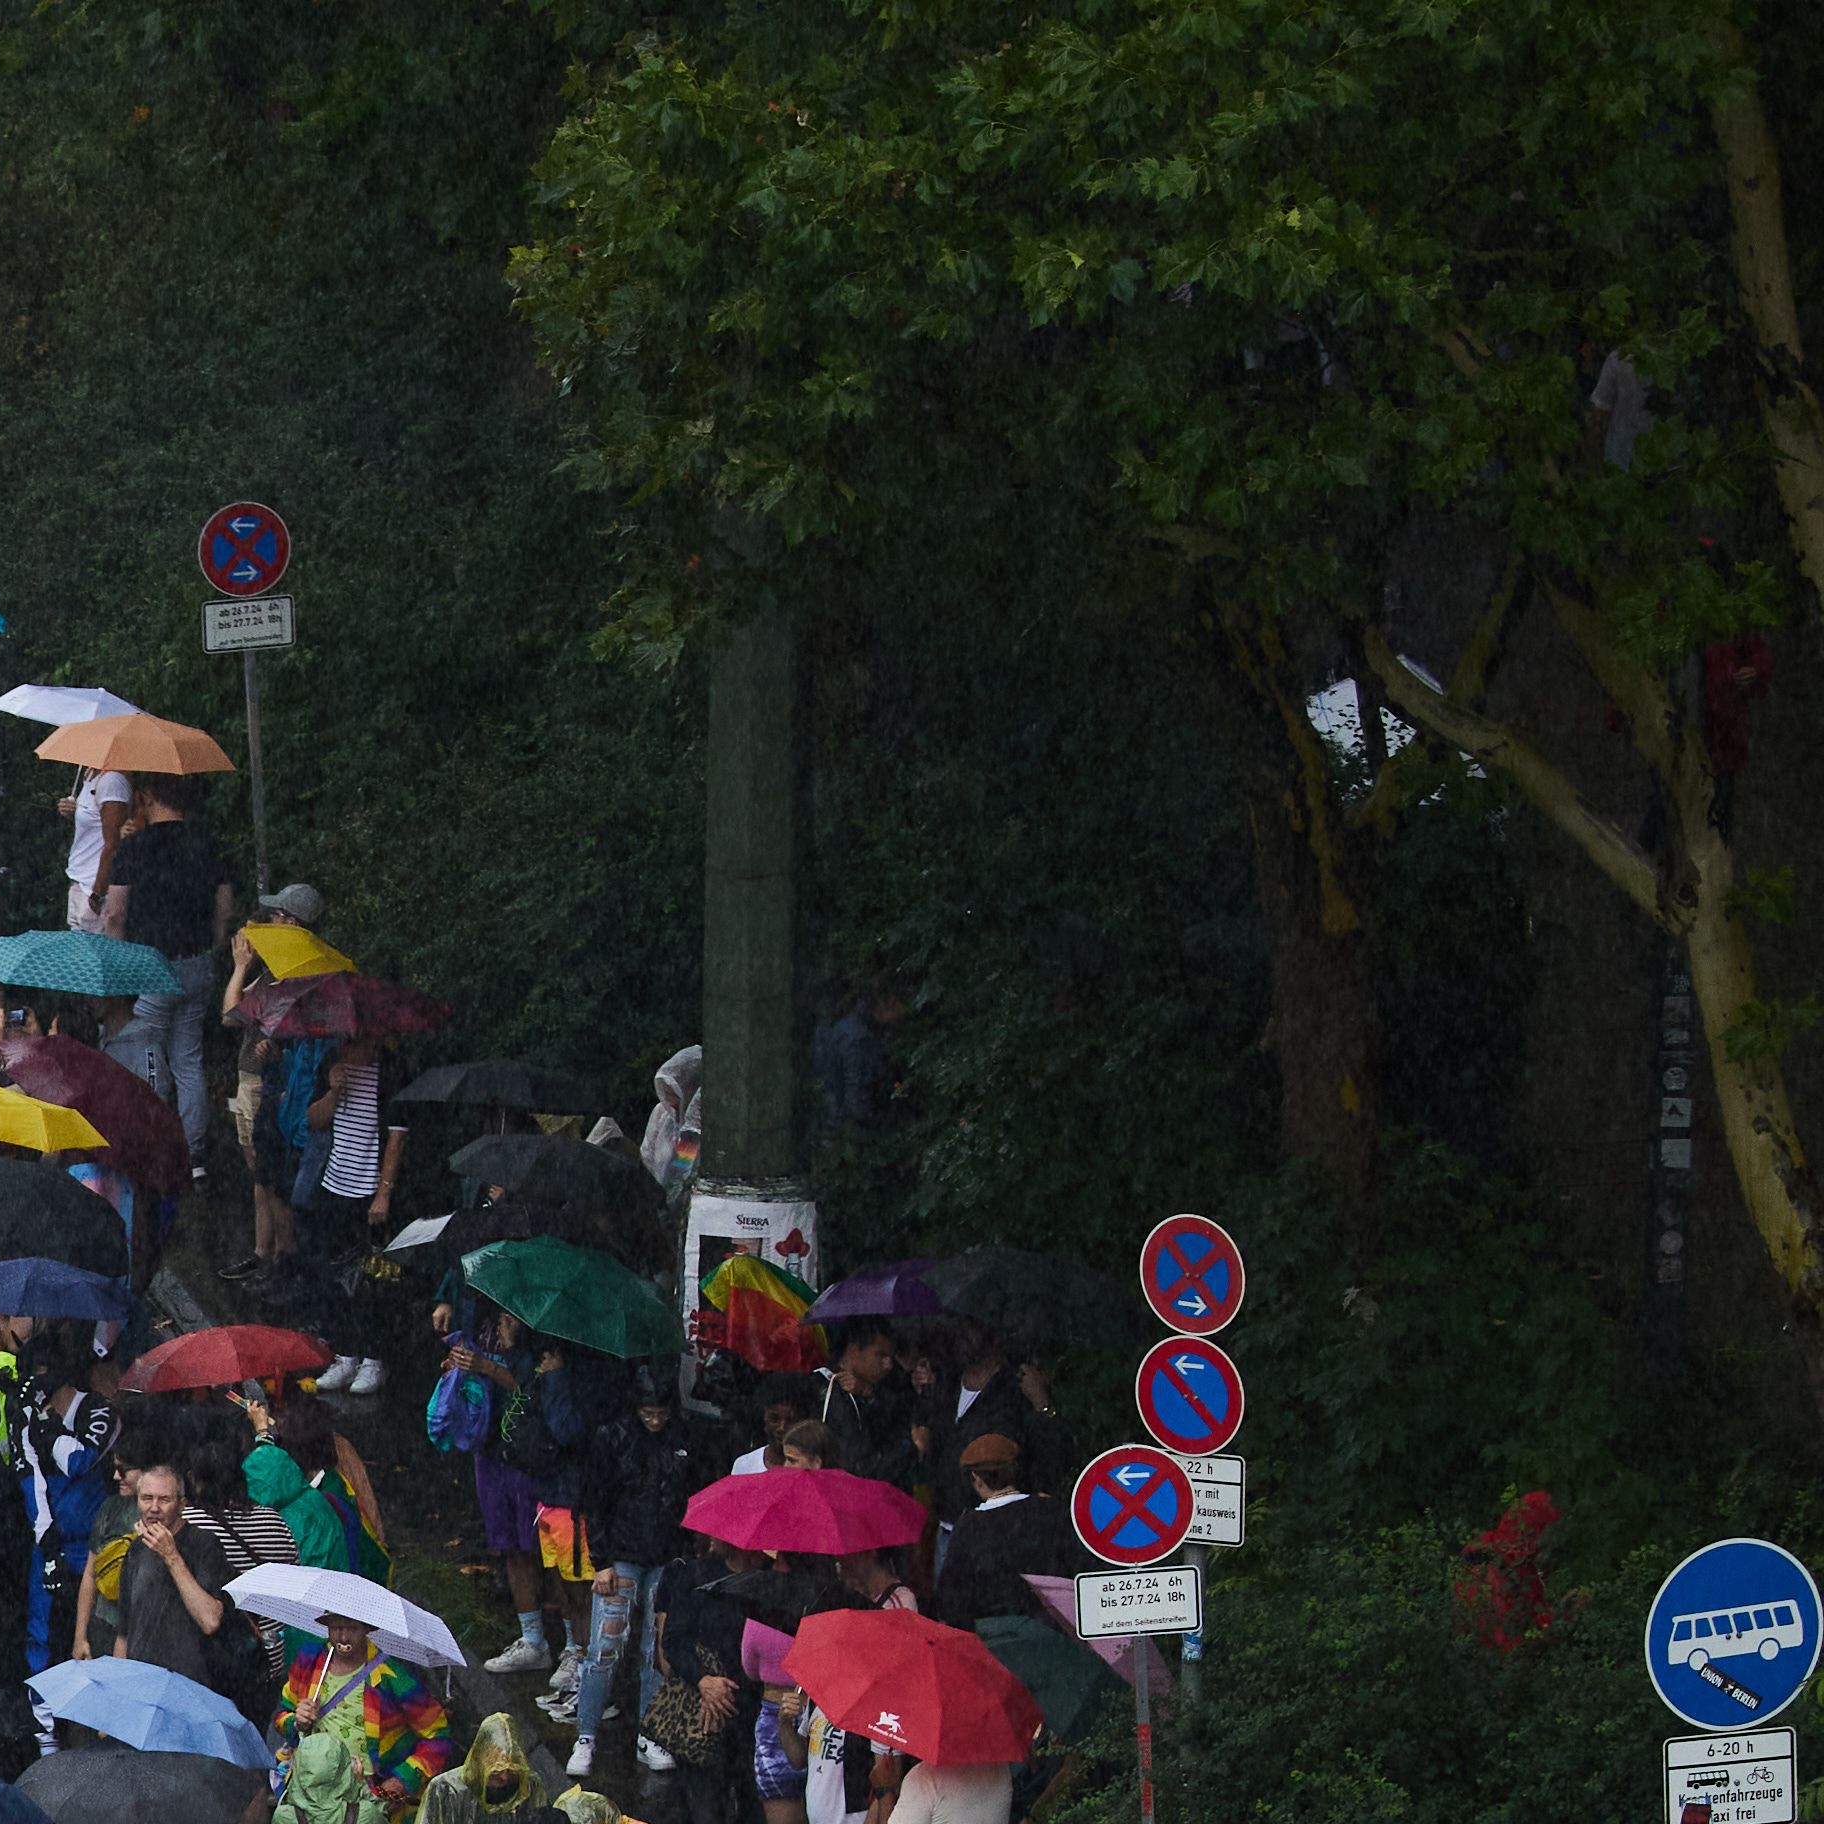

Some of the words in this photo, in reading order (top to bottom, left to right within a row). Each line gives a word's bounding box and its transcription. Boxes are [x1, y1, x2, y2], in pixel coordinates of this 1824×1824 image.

[1102, 1582, 1116, 1593] ab
[1119, 1579, 1159, 1592] 26.7.24
[1168, 1577, 1182, 1588] 6h
[1101, 1597, 1118, 1609] bis
[1121, 1593, 1161, 1607] 27.7.24
[1167, 1592, 1186, 1603] 18h
[1101, 1620, 1116, 1631] auf
[1119, 1618, 1133, 1629] dem
[1701, 1664, 1725, 1687] UNION
[1731, 1688, 1759, 1710] BERLIN
[1707, 1741, 1740, 1757] 6-20
[1747, 1740, 1754, 1753] h
[1735, 1807, 1756, 1822] frei
